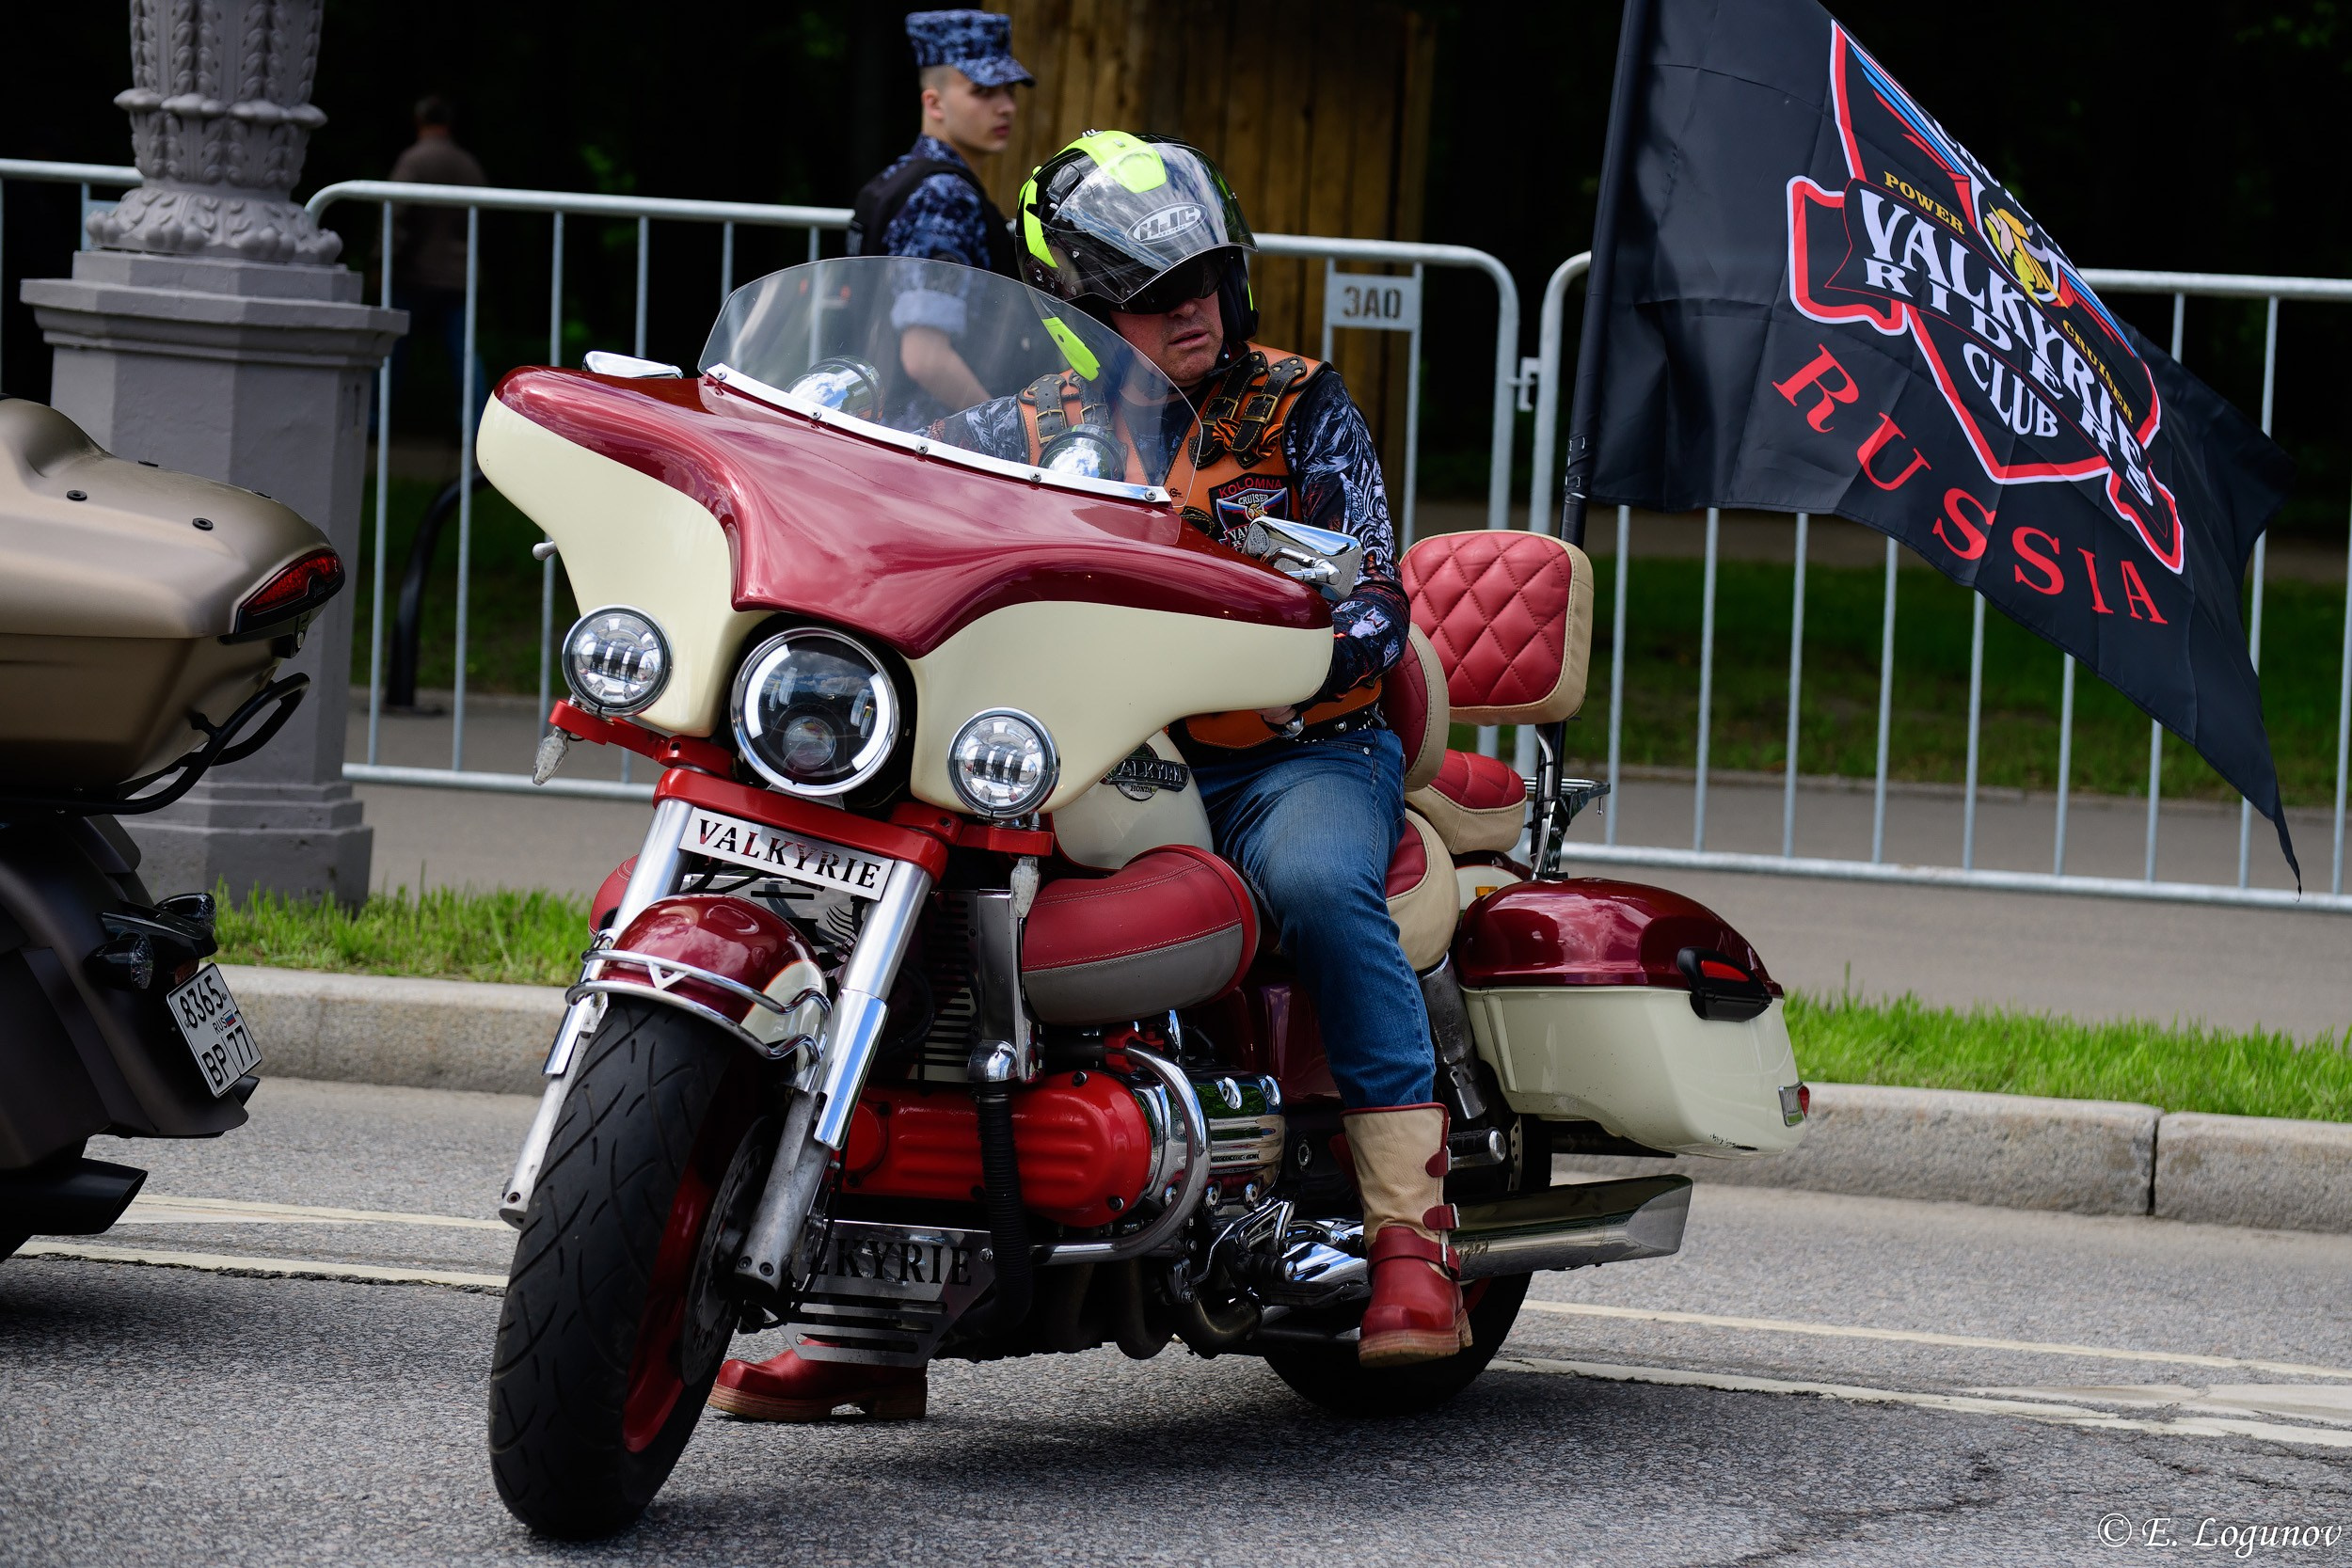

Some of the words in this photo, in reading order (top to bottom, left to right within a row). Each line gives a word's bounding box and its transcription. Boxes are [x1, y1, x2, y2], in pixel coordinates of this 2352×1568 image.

[1140, 206, 1196, 241] HJC
[1883, 171, 1966, 235] POWER
[2062, 319, 2136, 424] CRUISER
[1859, 188, 2144, 467] VALKYRIE
[1864, 257, 2155, 506] RIDERS
[1963, 342, 2060, 438] CLUB
[1218, 477, 1283, 499] KOLOMNA
[1237, 493, 1270, 506] CRUISER
[1772, 342, 2169, 626] RUSSIA
[1130, 784, 1153, 794] HONDA
[698, 818, 882, 890] VALKYRIE
[179, 974, 225, 1030] 8365
[212, 1016, 228, 1035] RUS
[227, 1024, 254, 1068] 77
